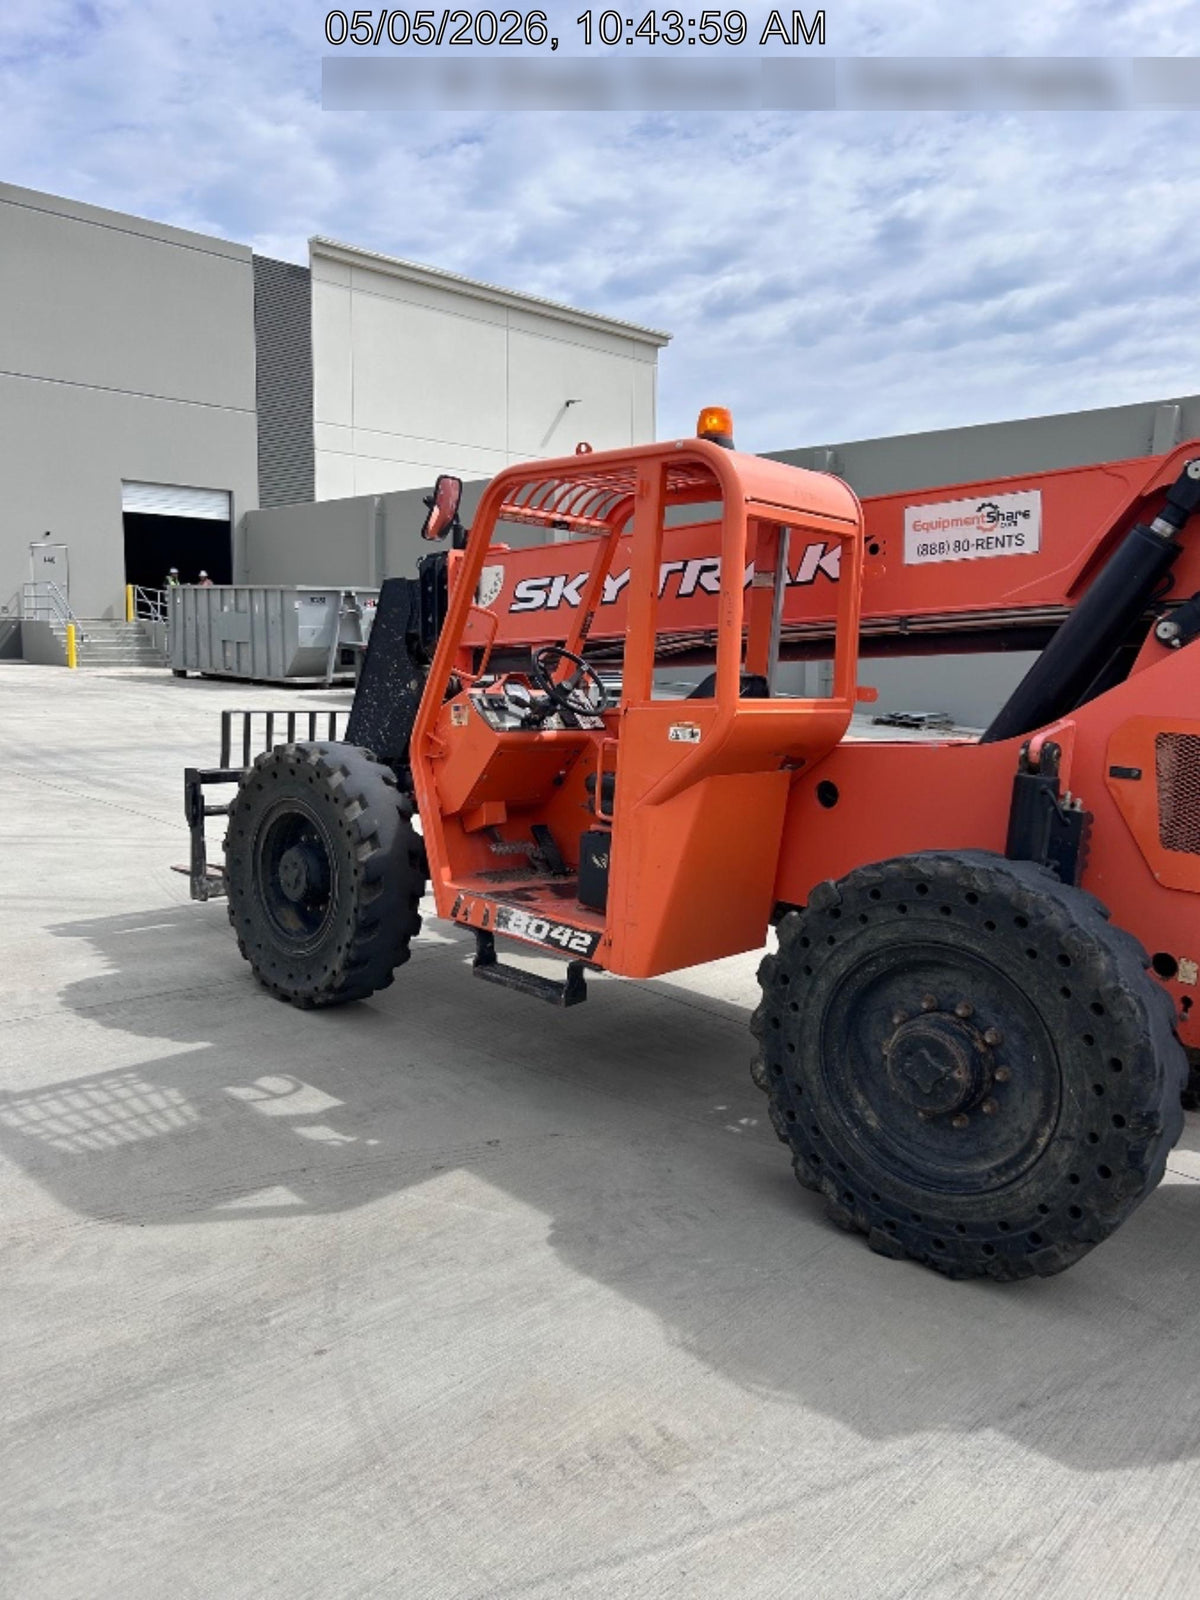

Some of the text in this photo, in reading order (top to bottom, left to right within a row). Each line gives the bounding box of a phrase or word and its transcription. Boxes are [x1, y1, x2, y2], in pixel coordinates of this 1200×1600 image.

[912, 508, 1031, 533] EquipmentShare
[917, 533, 1025, 557] (888) 80-RENTS
[506, 908, 593, 955] 8042
